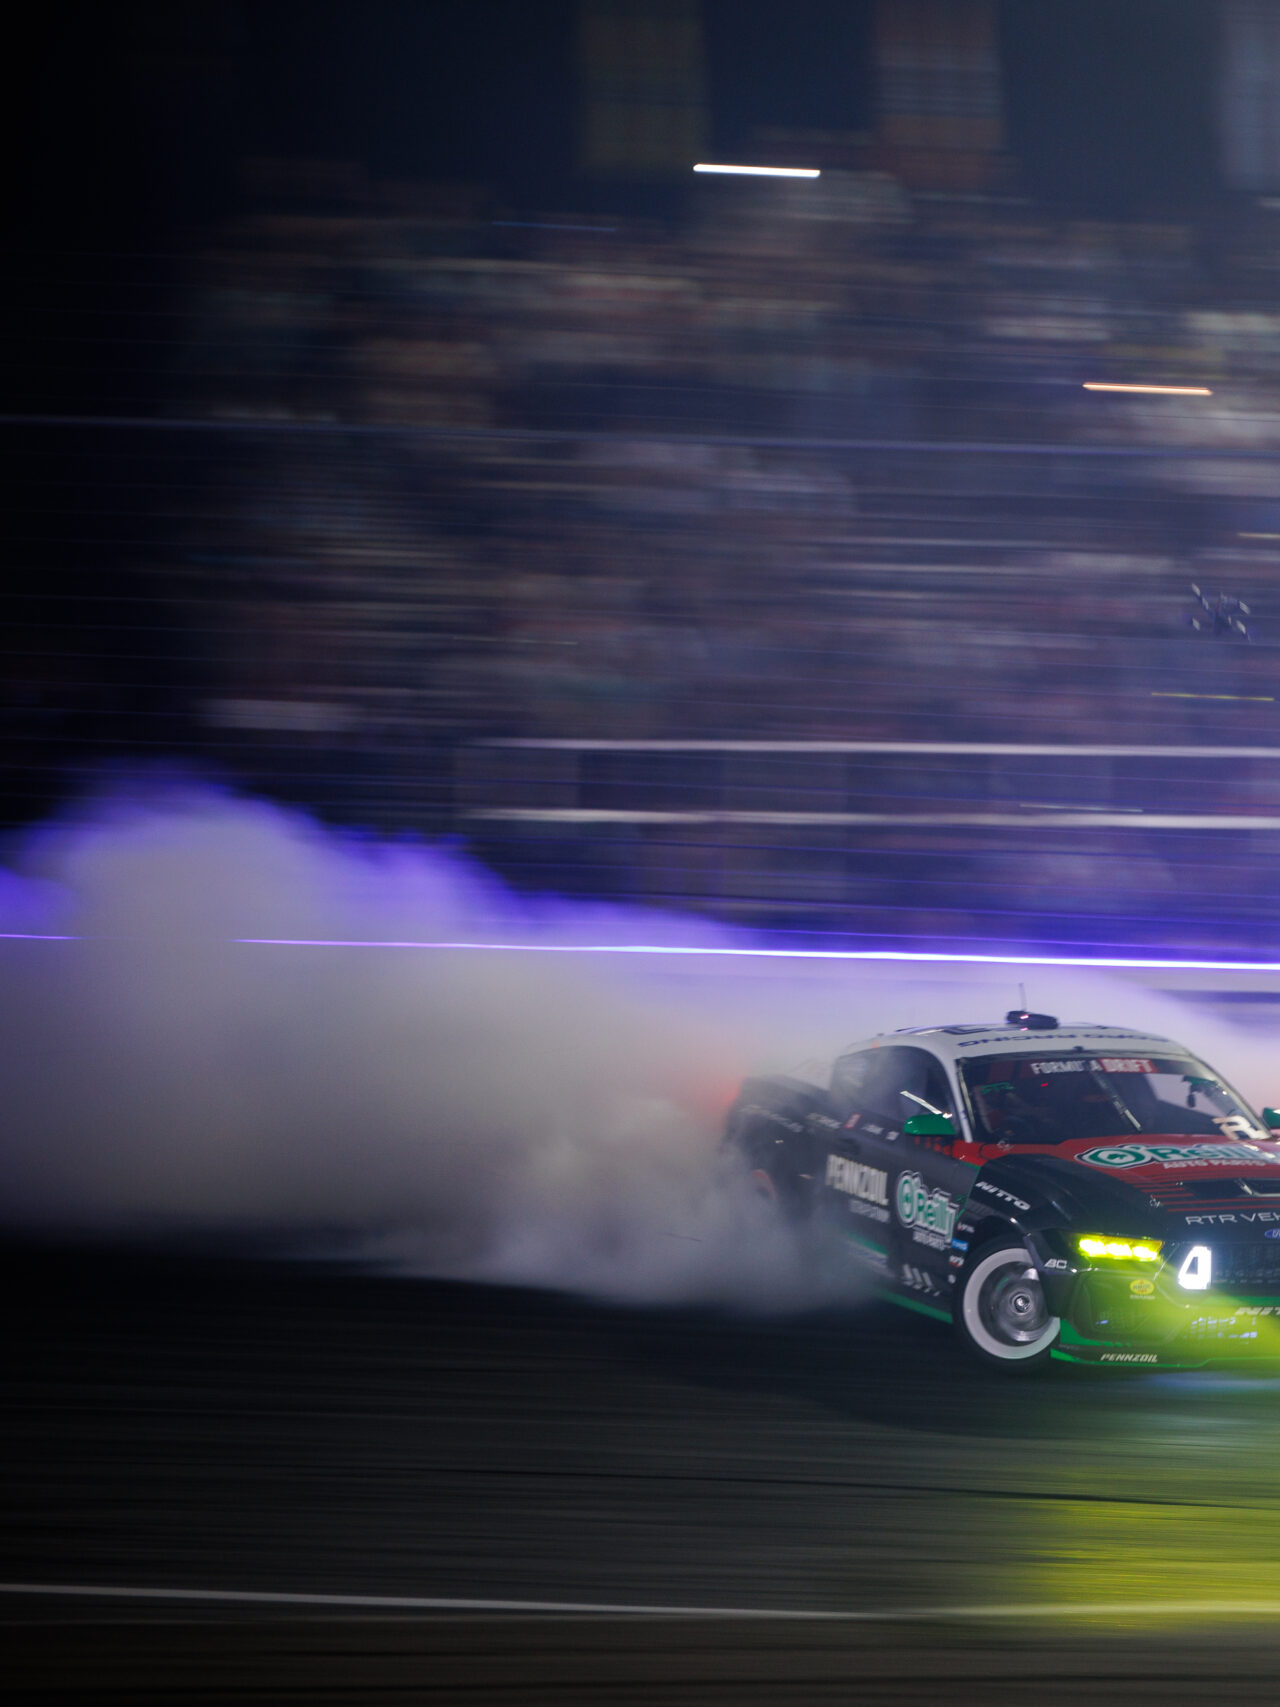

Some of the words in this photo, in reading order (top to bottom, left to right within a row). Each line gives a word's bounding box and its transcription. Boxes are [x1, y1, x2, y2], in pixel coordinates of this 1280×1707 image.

[975, 1181, 1031, 1211] NITTO
[1185, 1213, 1238, 1225] RTR
[1100, 1353, 1158, 1363] PENNZOIL
